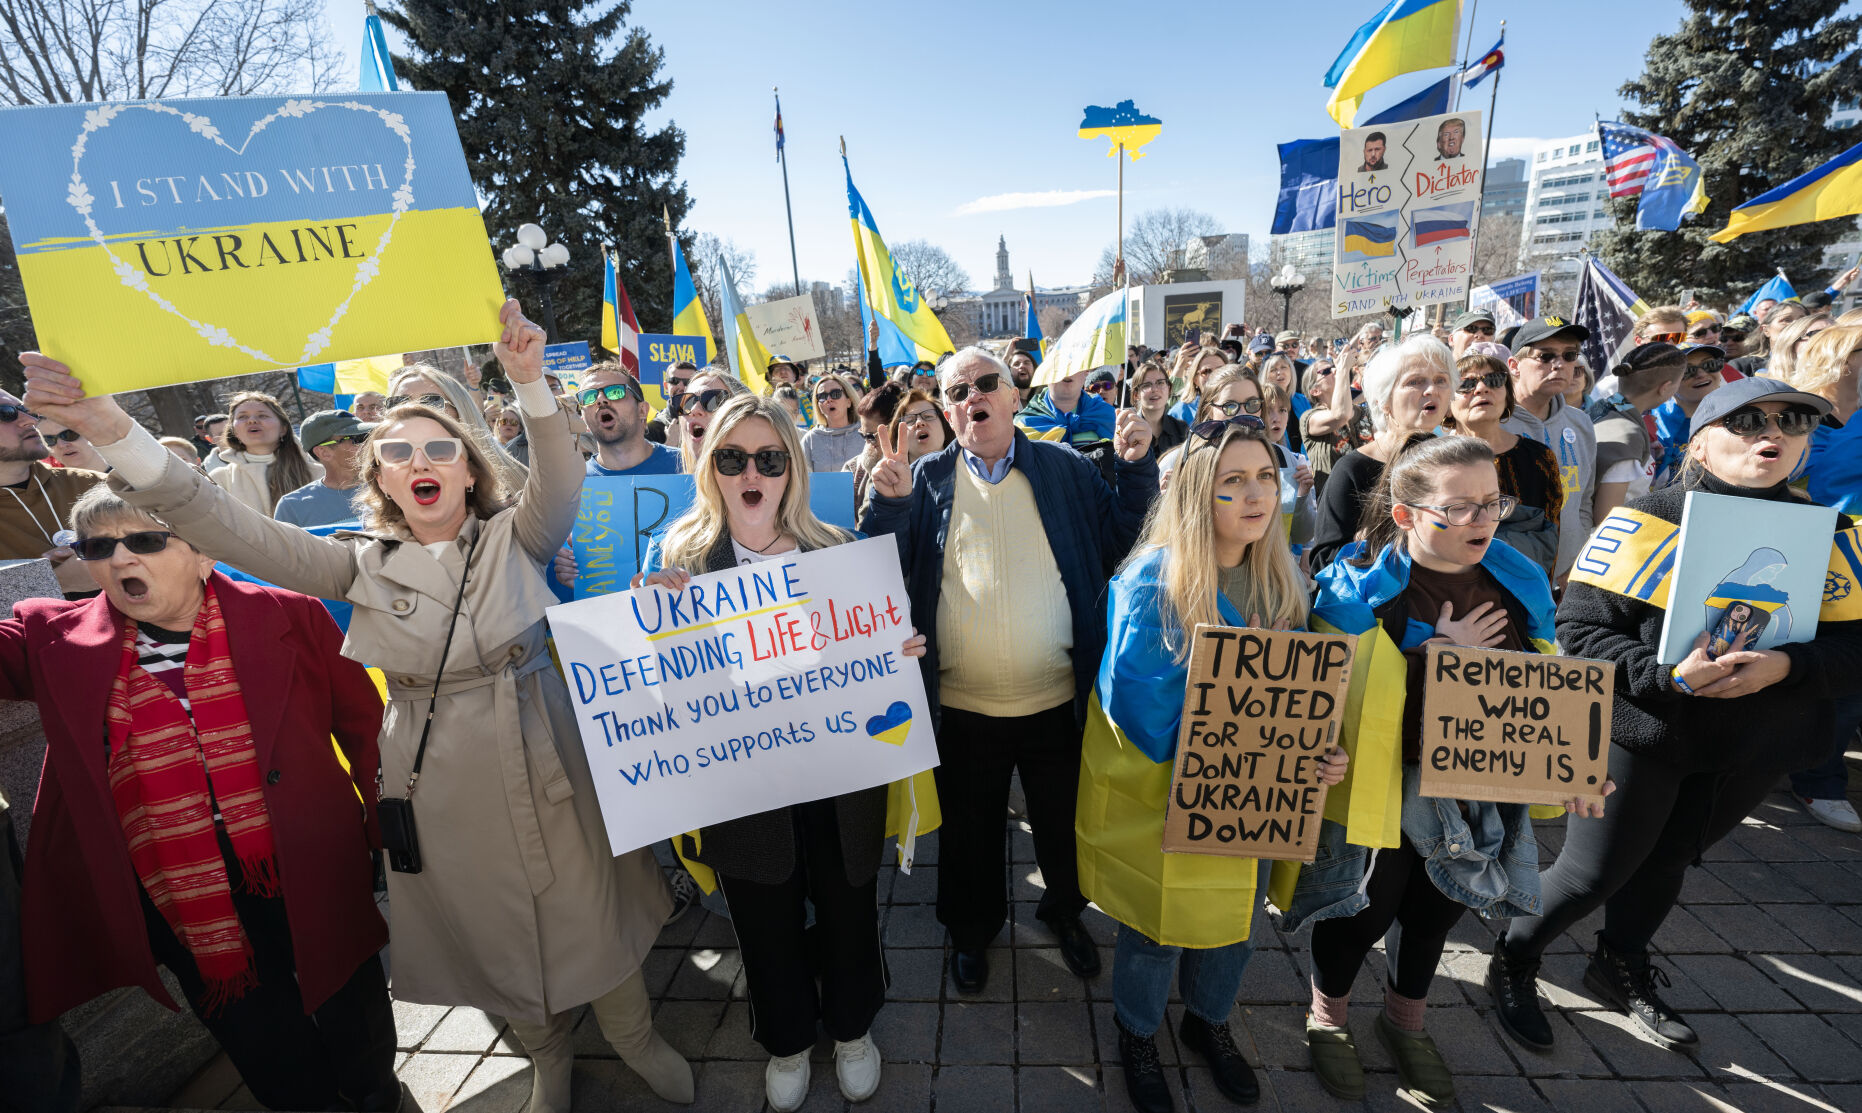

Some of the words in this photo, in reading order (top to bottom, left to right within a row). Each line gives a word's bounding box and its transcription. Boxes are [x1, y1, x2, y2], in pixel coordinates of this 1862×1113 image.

[110, 180, 126, 209] I
[136, 171, 269, 207] STAND
[280, 164, 388, 193] WITH
[1416, 164, 1480, 197] Dictator
[1339, 182, 1392, 214] Hero
[137, 224, 365, 277] UKRAINE
[1406, 258, 1466, 285] Perpetrators
[1338, 298, 1376, 314] STAND
[1383, 293, 1408, 307] WITH
[1415, 286, 1463, 301] UKRAINE
[568, 355, 586, 363] HELP
[649, 343, 697, 364] SLAVA
[630, 563, 808, 635] UKRAINE
[570, 632, 744, 705] DEFENDING
[747, 612, 808, 662] LIFE
[687, 689, 740, 723] you
[744, 681, 773, 709] to
[1191, 682, 1215, 716] I
[1477, 694, 1550, 721] WHO
[1176, 783, 1320, 815] UKRAINE
